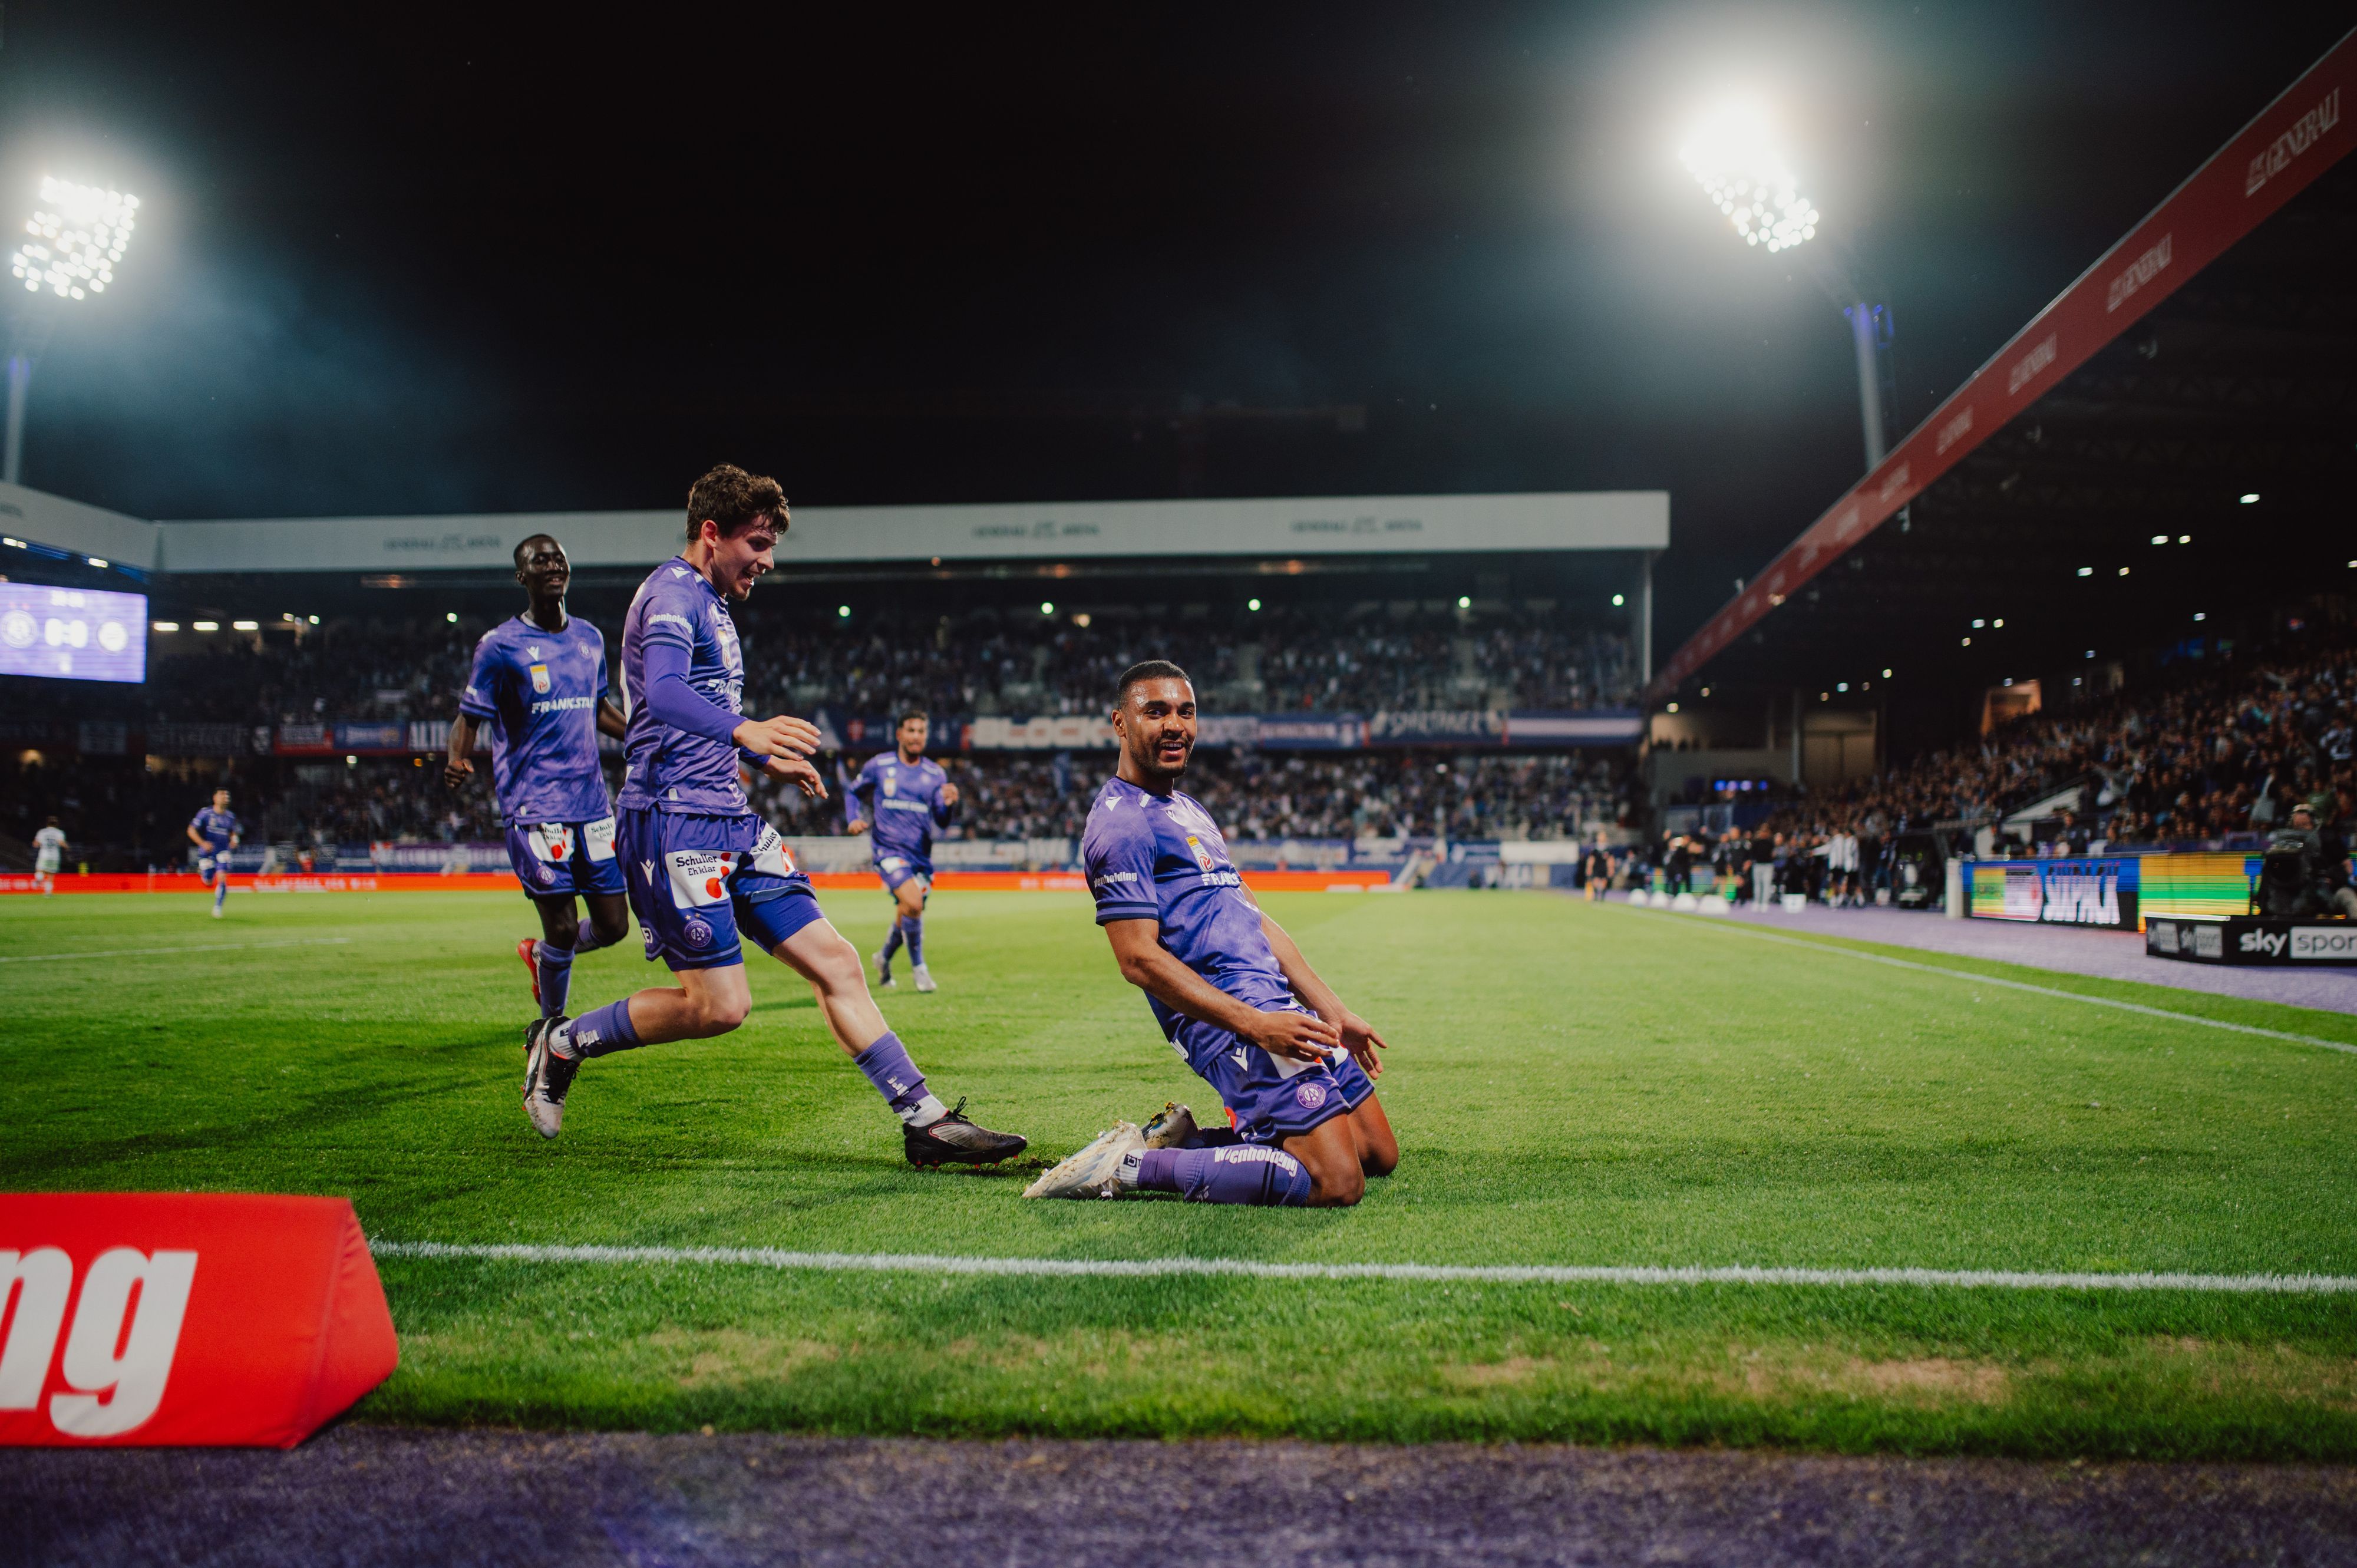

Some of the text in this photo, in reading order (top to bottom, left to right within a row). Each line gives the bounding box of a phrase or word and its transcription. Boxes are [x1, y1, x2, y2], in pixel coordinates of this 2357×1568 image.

[676, 854, 717, 867] Schuller
[2240, 927, 2287, 957] sky
[2297, 934, 2357, 956] spor
[0, 1246, 199, 1438] ng
